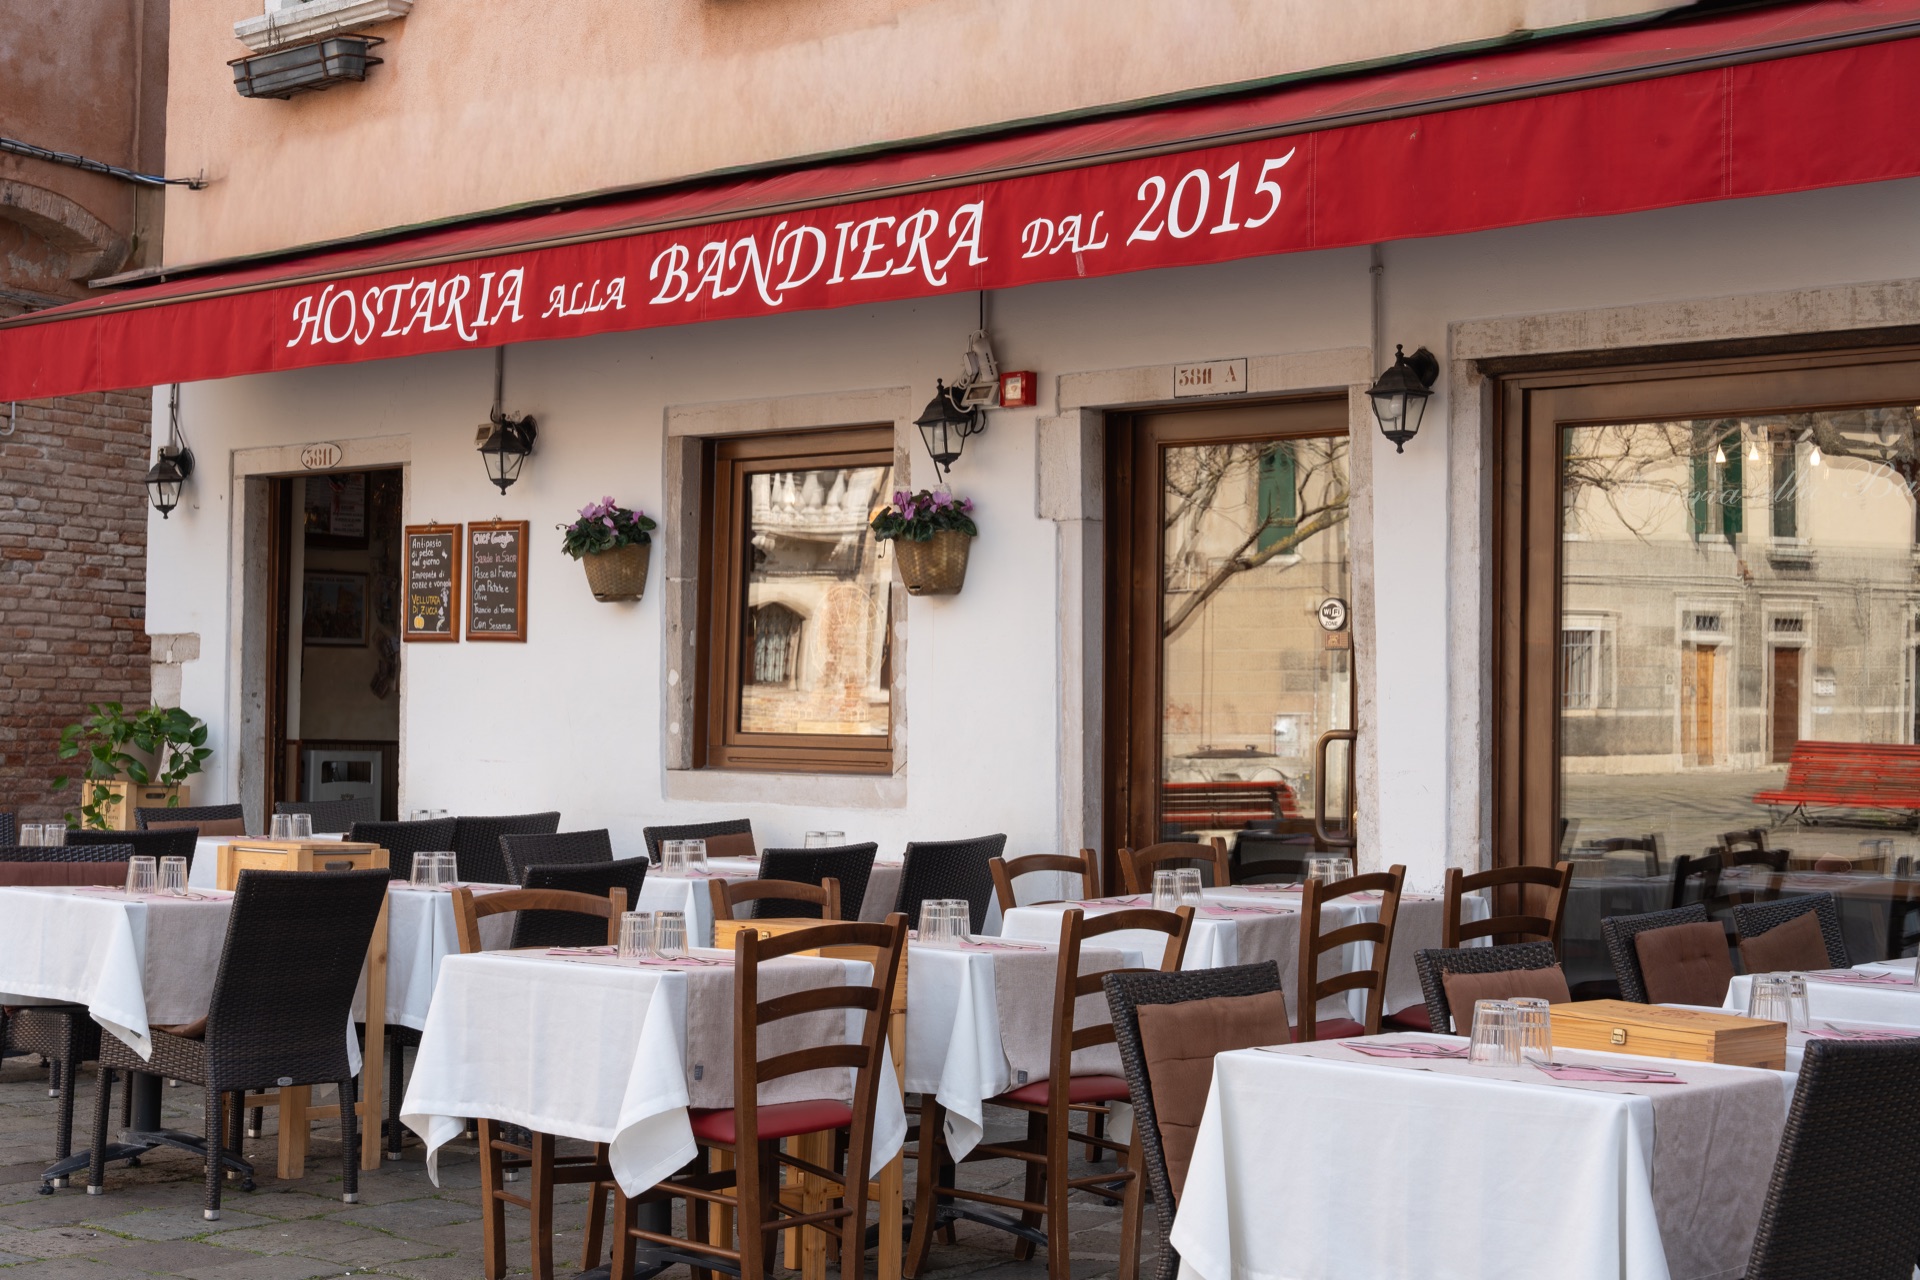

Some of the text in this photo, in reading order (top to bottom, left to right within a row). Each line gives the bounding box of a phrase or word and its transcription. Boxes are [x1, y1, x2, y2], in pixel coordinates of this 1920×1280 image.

[286, 146, 1296, 347] HOSTARIA ALLA BANDIERA DAL 2015
[1179, 364, 1237, 387] 3811 A
[306, 447, 333, 466] 3811
[412, 538, 442, 552] Antipasto
[422, 558, 440, 569] giorno
[438, 569, 445, 578] di
[474, 565, 489, 579] Pesce
[490, 568, 497, 578] al
[473, 617, 487, 629] Con
